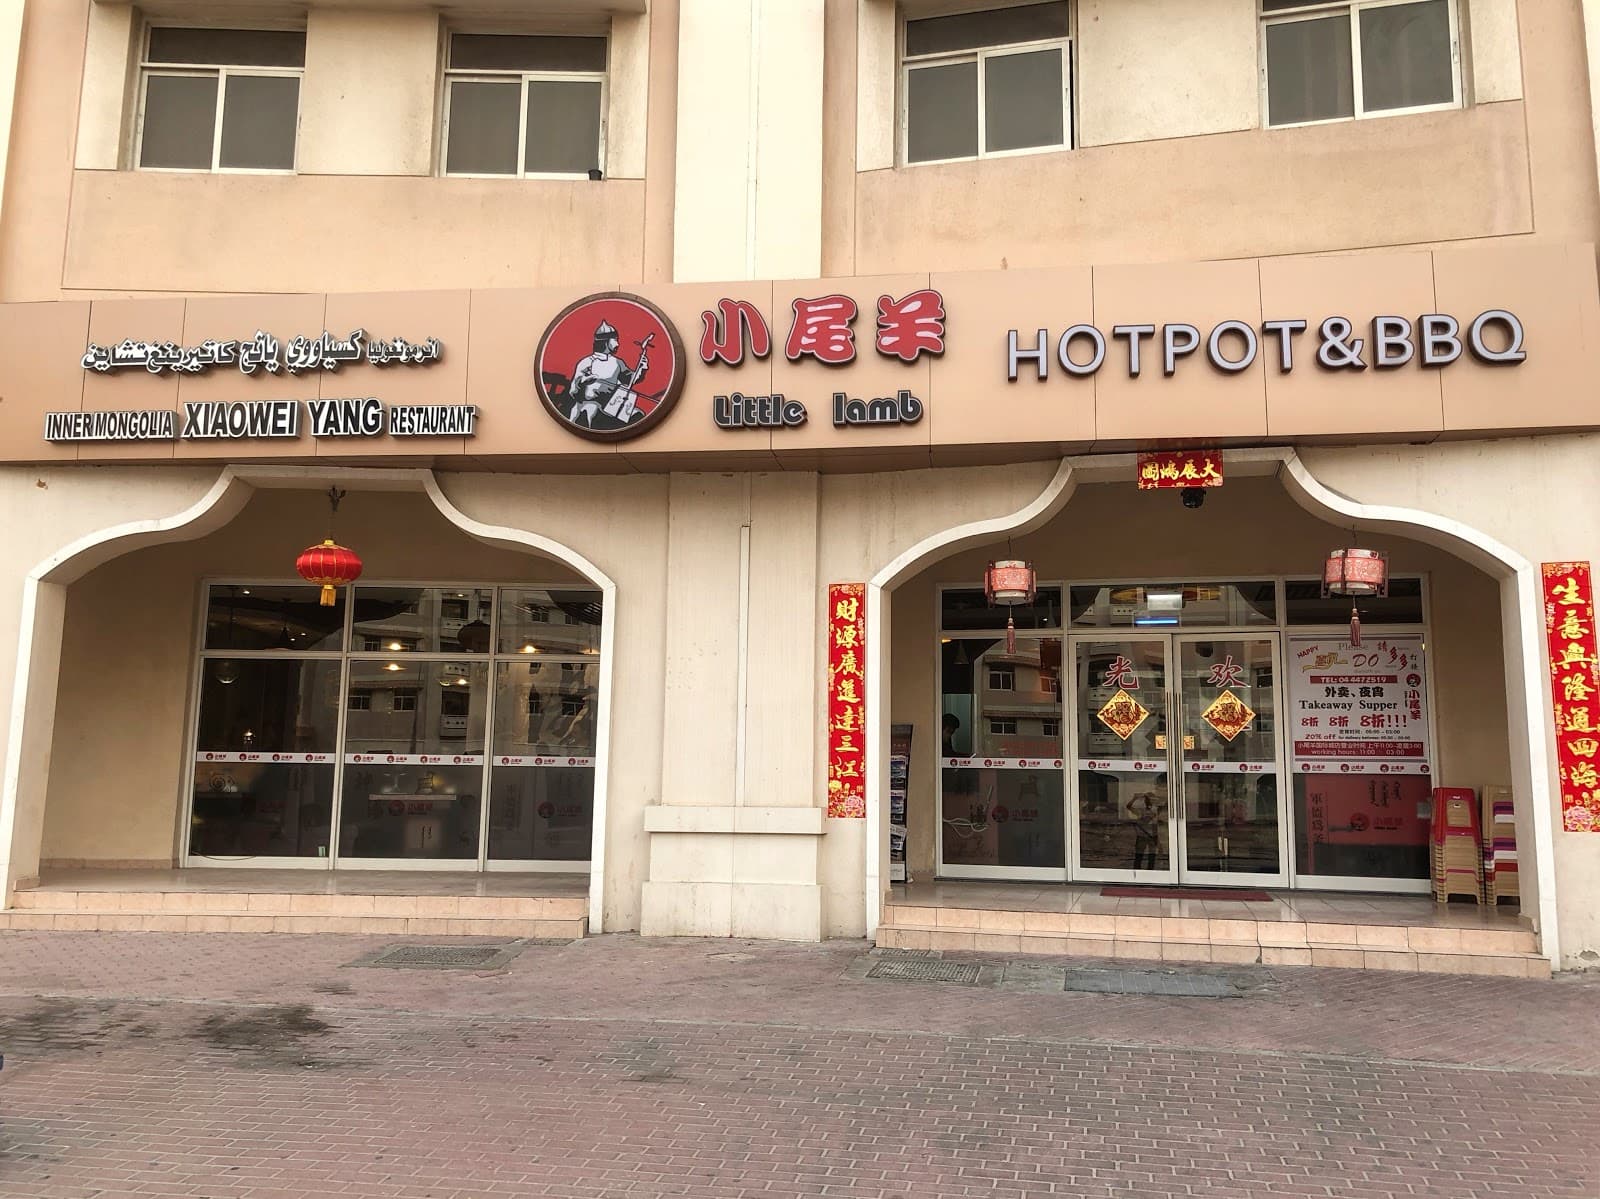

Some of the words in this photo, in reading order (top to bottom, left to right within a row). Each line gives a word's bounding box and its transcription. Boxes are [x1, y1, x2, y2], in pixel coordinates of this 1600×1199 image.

[700, 288, 946, 367] 小尾羊
[1007, 309, 1527, 382] HOTPOT&BBQ
[45, 412, 93, 440] INNER
[93, 410, 177, 440] MONGOLIA
[182, 400, 302, 438] XIAOWEI
[307, 398, 385, 436] YANG
[389, 404, 477, 437] RESTAURANT
[713, 393, 808, 430] Little
[833, 390, 923, 428] lamb
[1102, 655, 1140, 690] 光
[1207, 655, 1249, 688] 欢
[1299, 700, 1353, 711] Takeaway
[1359, 700, 1398, 711] Supper
